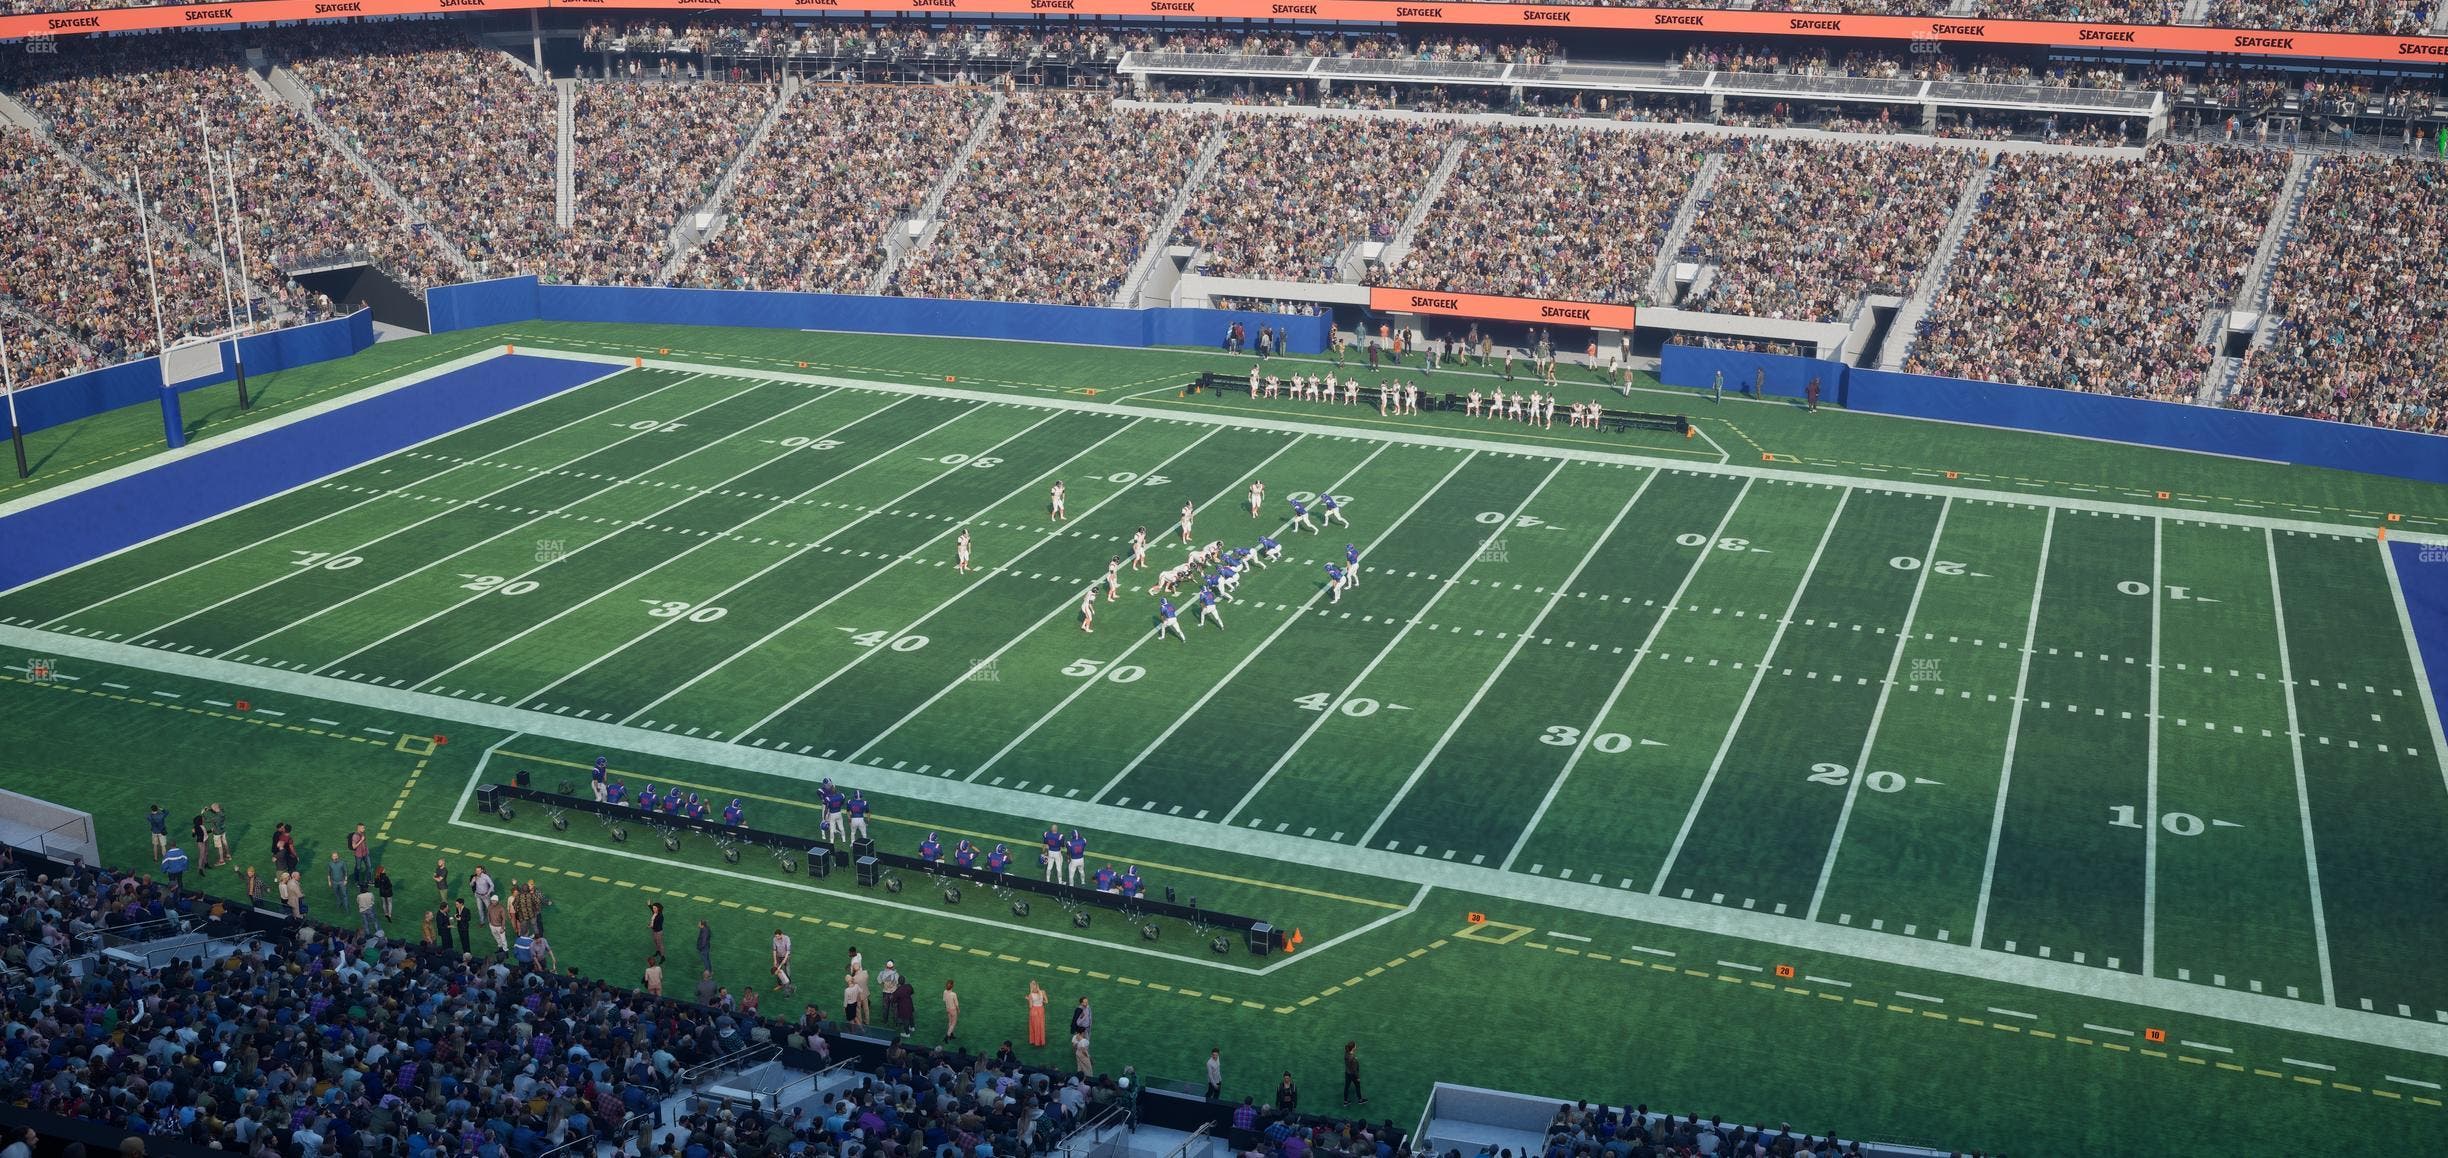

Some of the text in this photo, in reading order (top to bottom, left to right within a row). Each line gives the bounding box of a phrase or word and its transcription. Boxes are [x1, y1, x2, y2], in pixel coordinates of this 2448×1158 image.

[315, 2, 361, 13] SEATGEEK
[1030, 0, 1074, 9] SEATGEEK
[1151, 2, 1195, 11] SEATGEEK
[1272, 4, 1317, 14] SEATGEEK
[185, 8, 233, 21] SEATGEEK
[1396, 7, 1442, 17] SEATGEEK
[1523, 11, 1570, 21] SEATGEEK
[49, 16, 100, 30] SEATGEEK
[1654, 14, 1703, 25] SEATGEEK
[1790, 19, 1841, 30] SEATGEEK
[1932, 23, 1985, 36] SEATGEEK
[2079, 29, 2135, 41] SEATGEEK
[2234, 36, 2295, 50] SEATGEEK
[1411, 296, 1459, 310] SEATGEEK
[1541, 306, 1590, 320] SEATGEEK
[290, 552, 364, 570] 10
[460, 575, 540, 596] 20
[648, 601, 728, 623] 30
[851, 630, 930, 652] 40
[1061, 657, 1146, 683] 50
[1292, 692, 1380, 717] 40
[1539, 725, 1632, 754] 30
[1807, 762, 1906, 793] 20
[2108, 805, 2205, 836] 10
[1780, 967, 1789, 975] 20
[2151, 1031, 2160, 1039] 10
